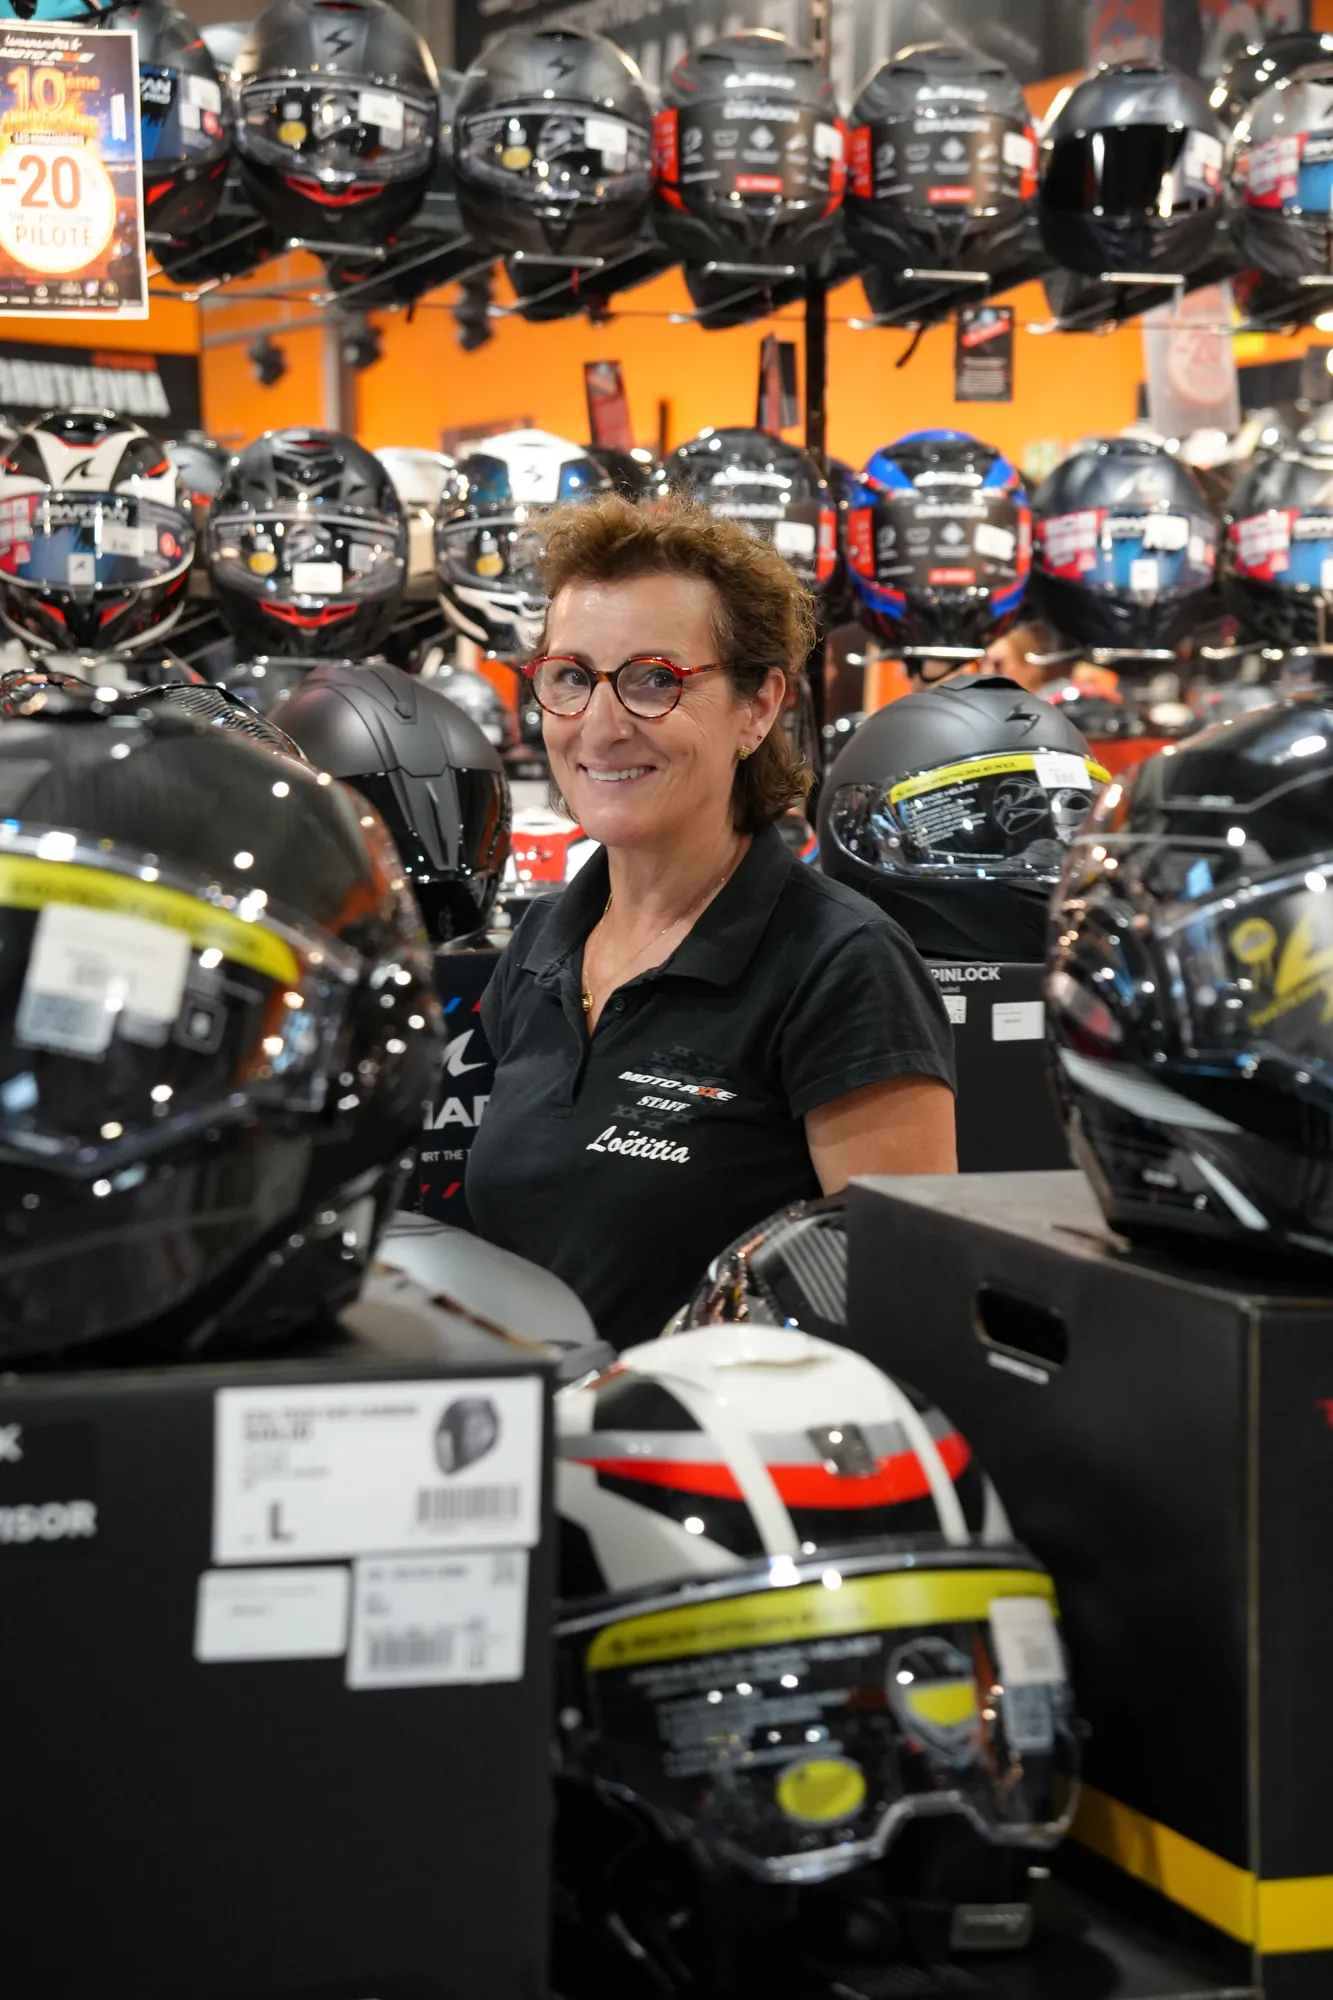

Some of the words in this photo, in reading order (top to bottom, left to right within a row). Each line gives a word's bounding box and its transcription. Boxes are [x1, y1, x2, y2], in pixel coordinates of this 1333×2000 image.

[6, 64, 66, 111] 10
[636, 1095, 691, 1112] STAFF
[443, 1149, 464, 1161] THE
